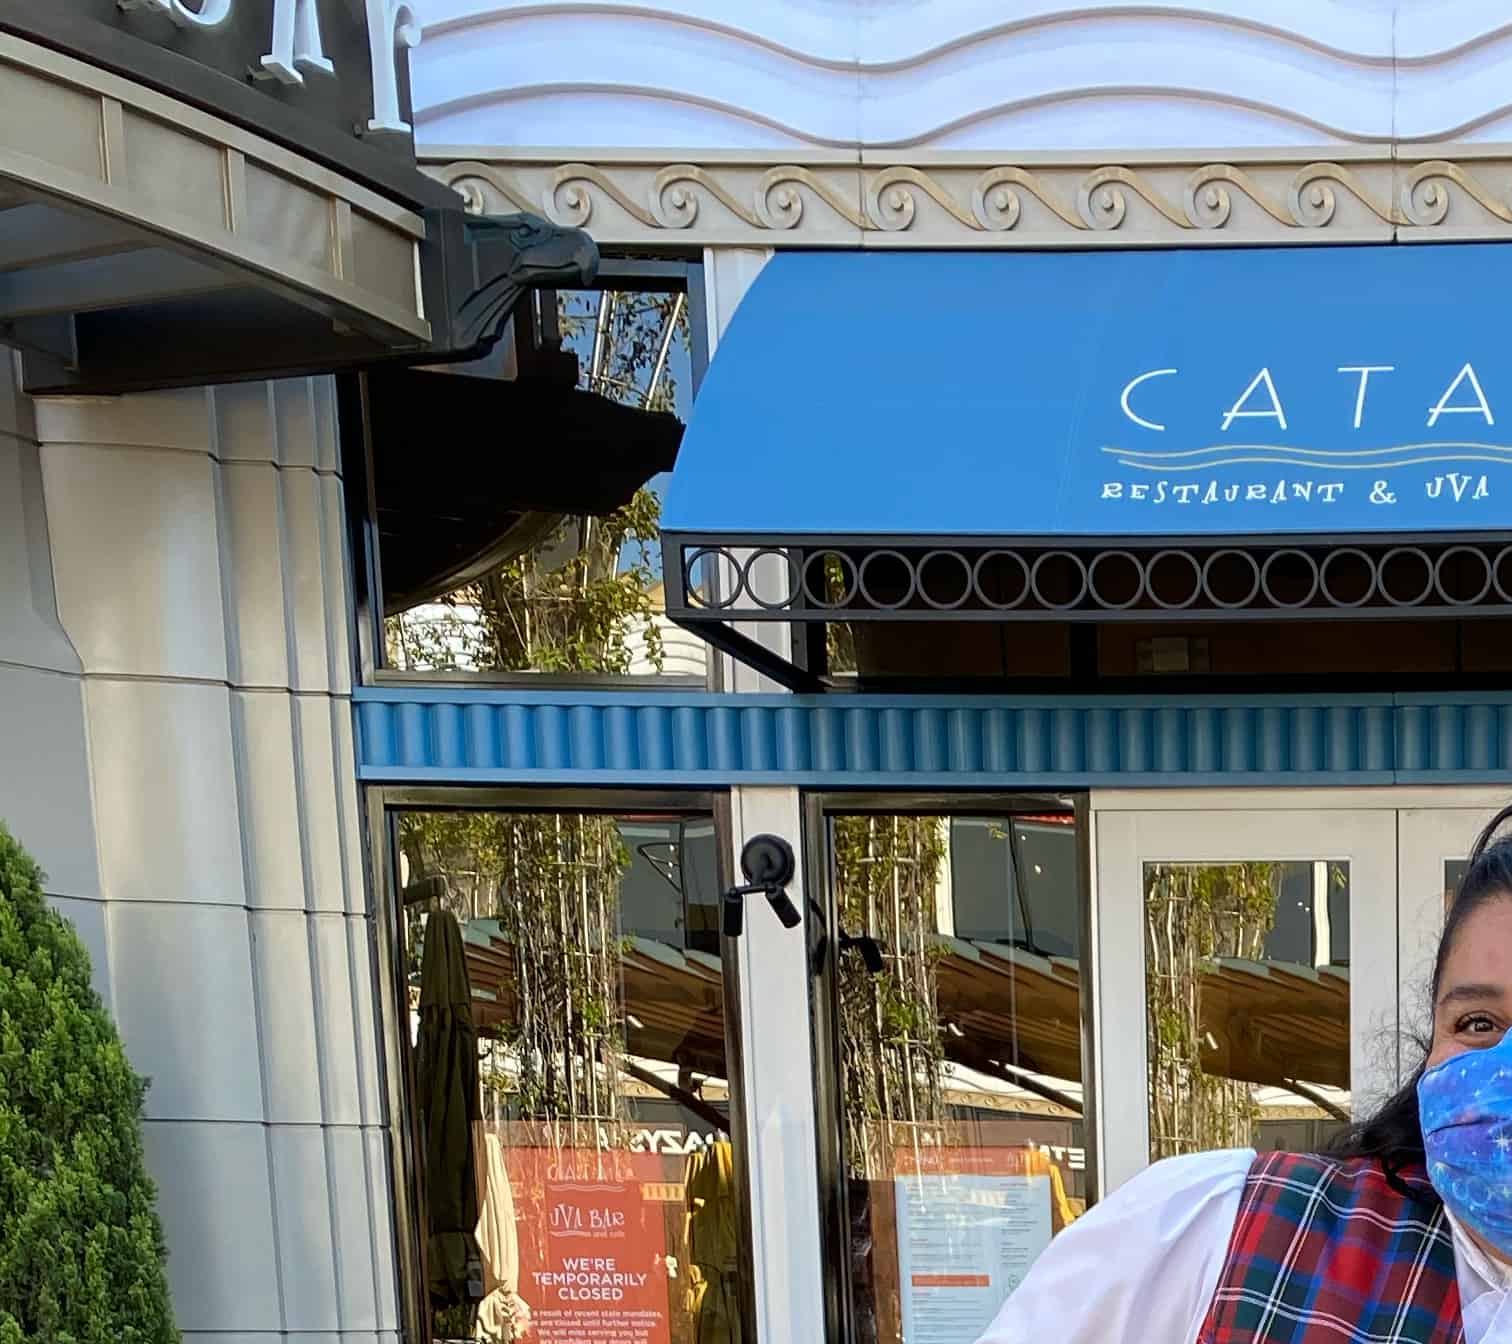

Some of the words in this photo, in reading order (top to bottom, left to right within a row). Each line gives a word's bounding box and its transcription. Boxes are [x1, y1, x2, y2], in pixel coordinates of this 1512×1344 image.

[1100, 480, 1345, 504] RESTAURANT
[1369, 480, 1398, 504] &
[1426, 472, 1490, 502] UVA
[588, 1207, 625, 1229] BAR
[563, 1257, 616, 1271] WE'RE
[531, 1272, 648, 1286] TEMPORARILY
[558, 1287, 623, 1301] CLOSED
